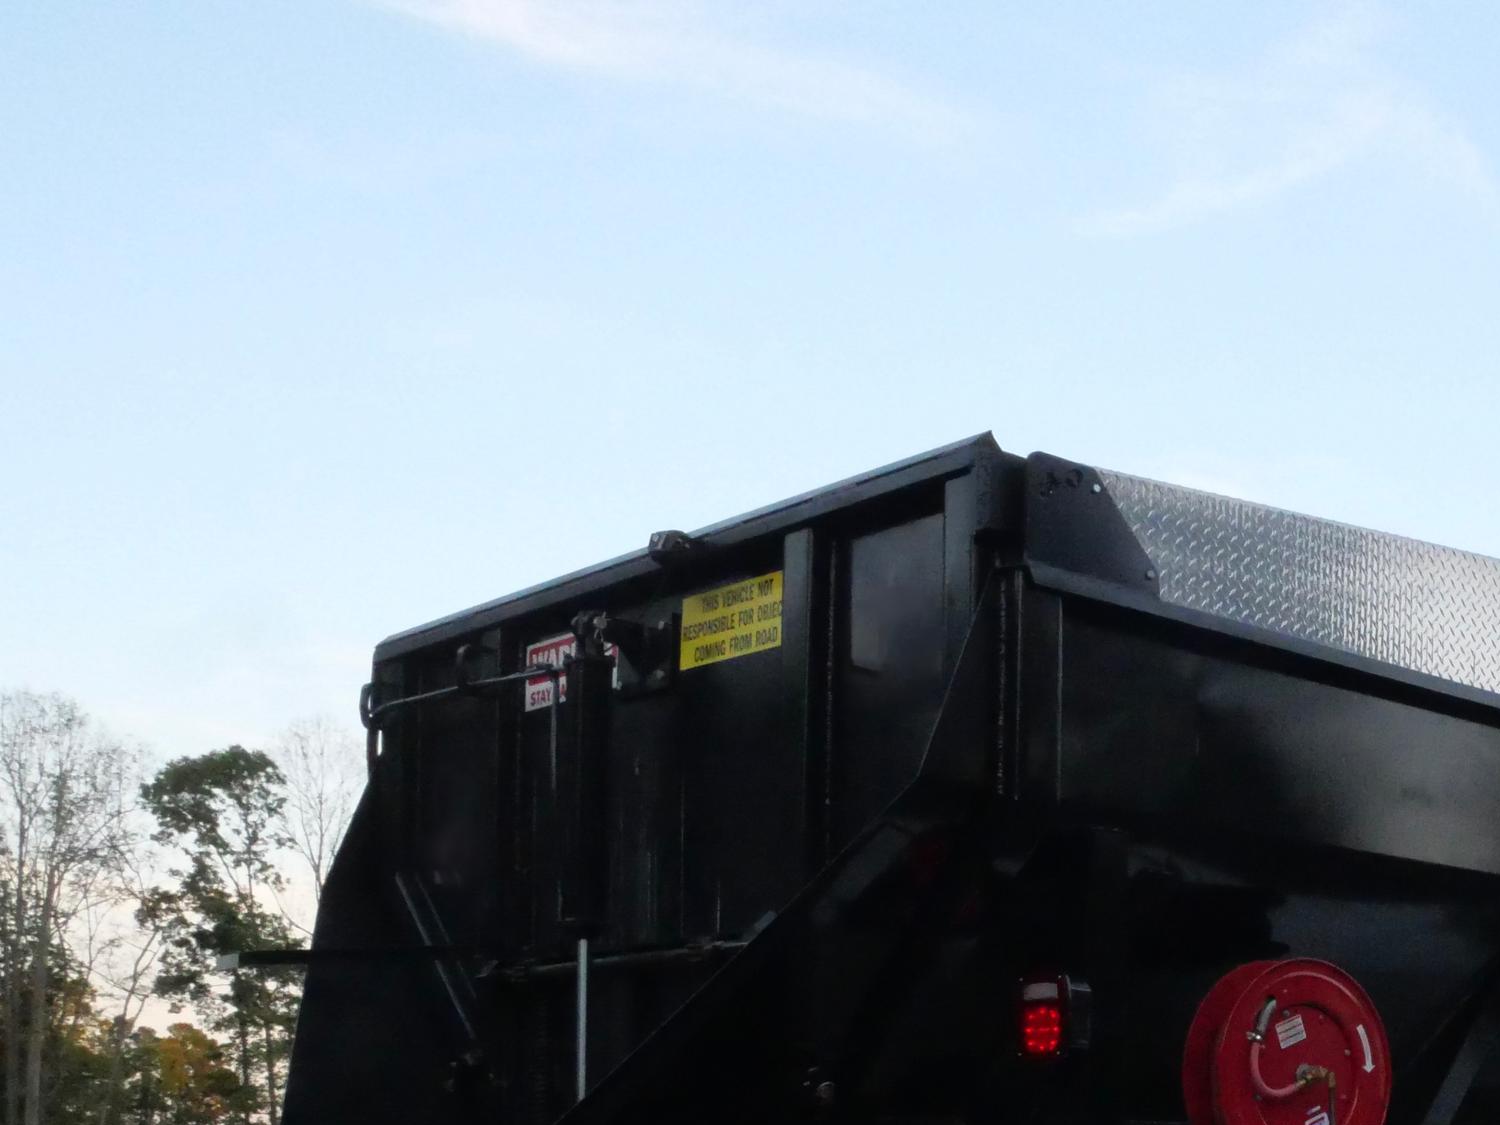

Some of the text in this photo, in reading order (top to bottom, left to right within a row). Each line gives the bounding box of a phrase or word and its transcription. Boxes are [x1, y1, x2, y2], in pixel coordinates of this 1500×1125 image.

[701, 578, 775, 613] THIS VEHICLE NOT
[682, 612, 736, 642] RESPONSIBLE
[738, 607, 755, 627] FOR
[694, 625, 778, 663] COMING FROM ROAD
[530, 687, 552, 707] STAY
